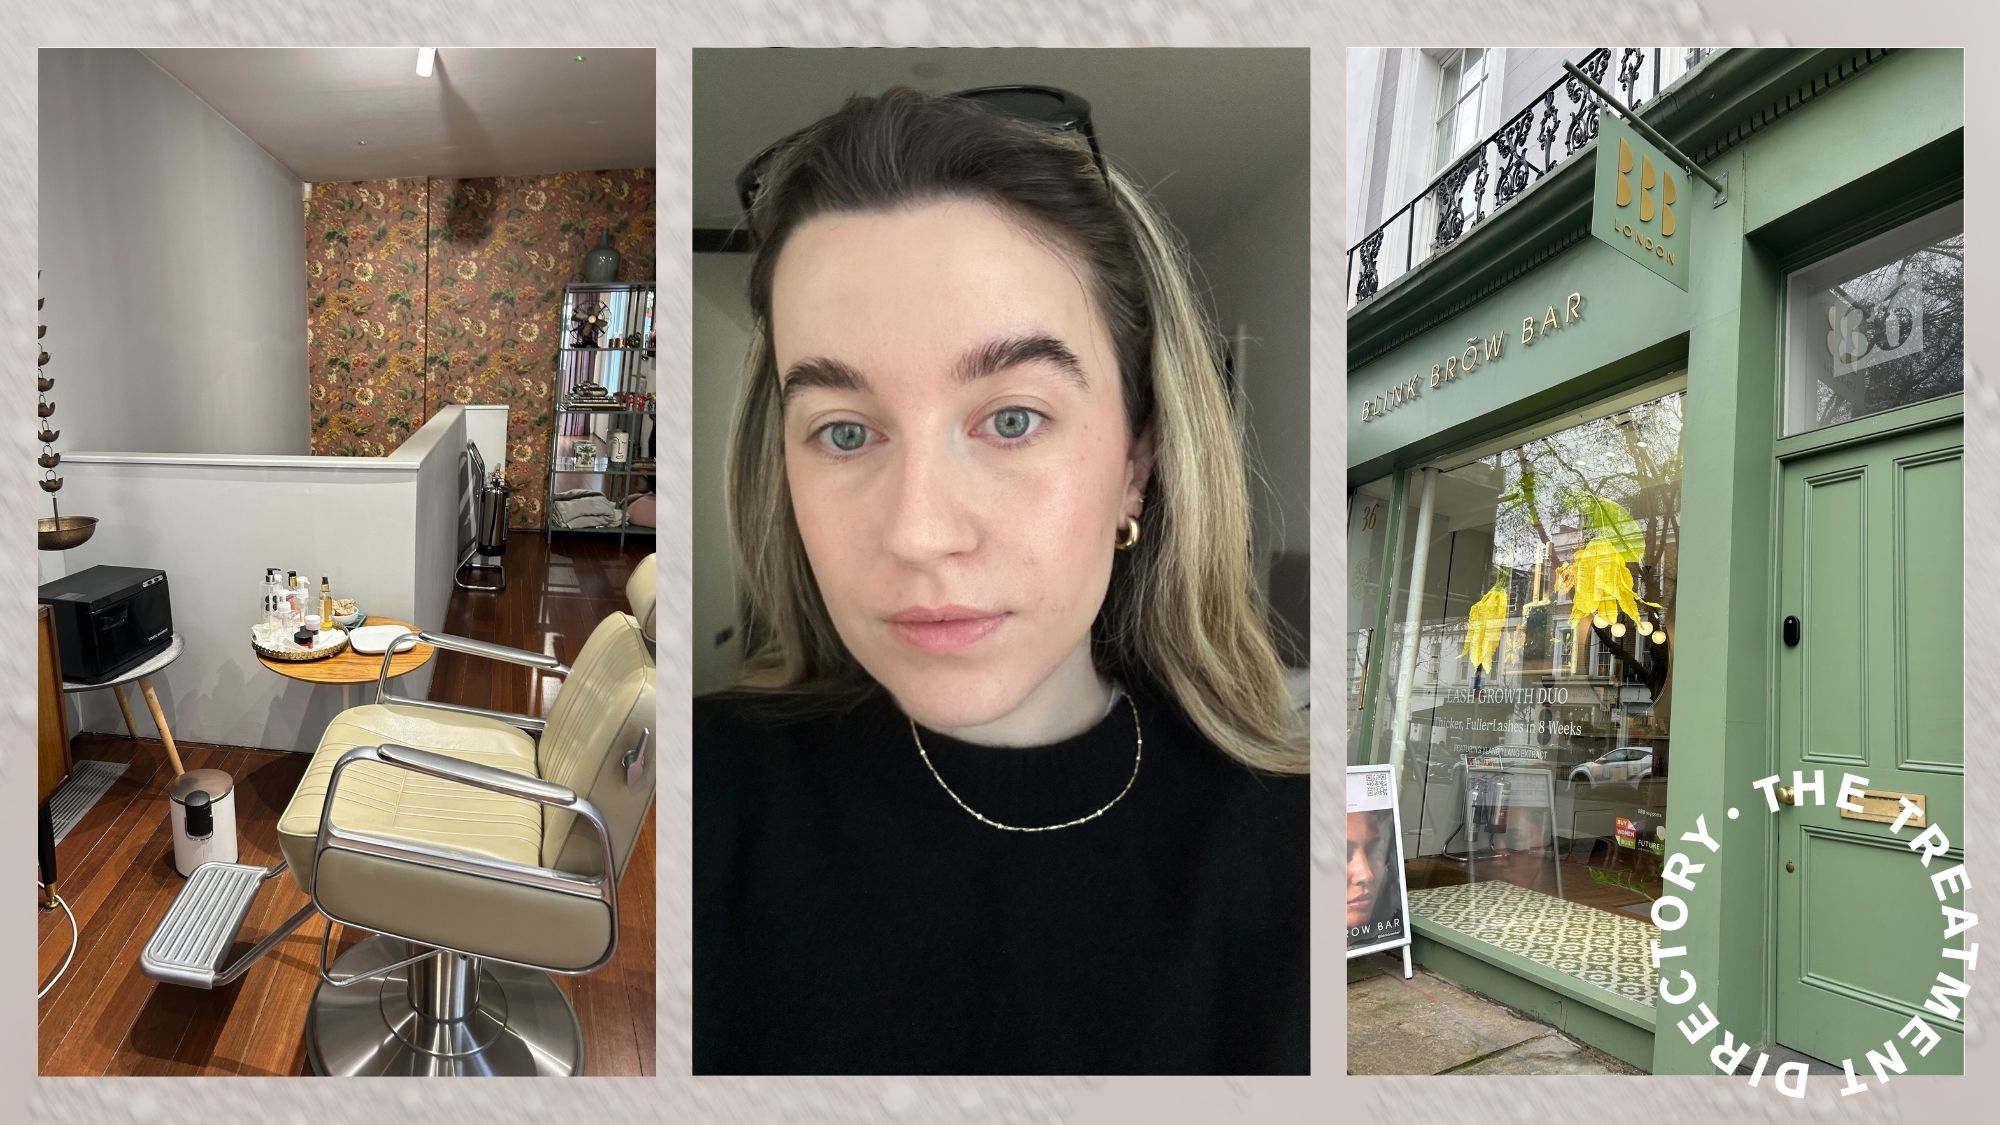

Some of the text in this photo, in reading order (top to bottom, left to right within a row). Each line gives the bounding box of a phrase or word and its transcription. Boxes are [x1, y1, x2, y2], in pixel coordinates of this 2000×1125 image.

[1616, 136, 1678, 237] BBB
[1614, 218, 1676, 265] LONDON
[1361, 374, 1419, 421] BLINK
[1521, 292, 1582, 345] BAR
[1362, 503, 1380, 532] 36
[1446, 688, 1475, 704] LASH
[1478, 687, 1534, 704] GROWTH
[1537, 687, 1569, 705] DUO
[1433, 716, 1582, 736] Thicker, Fuller Lashes in 8 Weeks
[1453, 744, 1482, 754] FEATURING
[1520, 748, 1548, 760] EXTRACT
[1617, 829, 1635, 838] WOMEN
[1377, 918, 1400, 931] BAR
